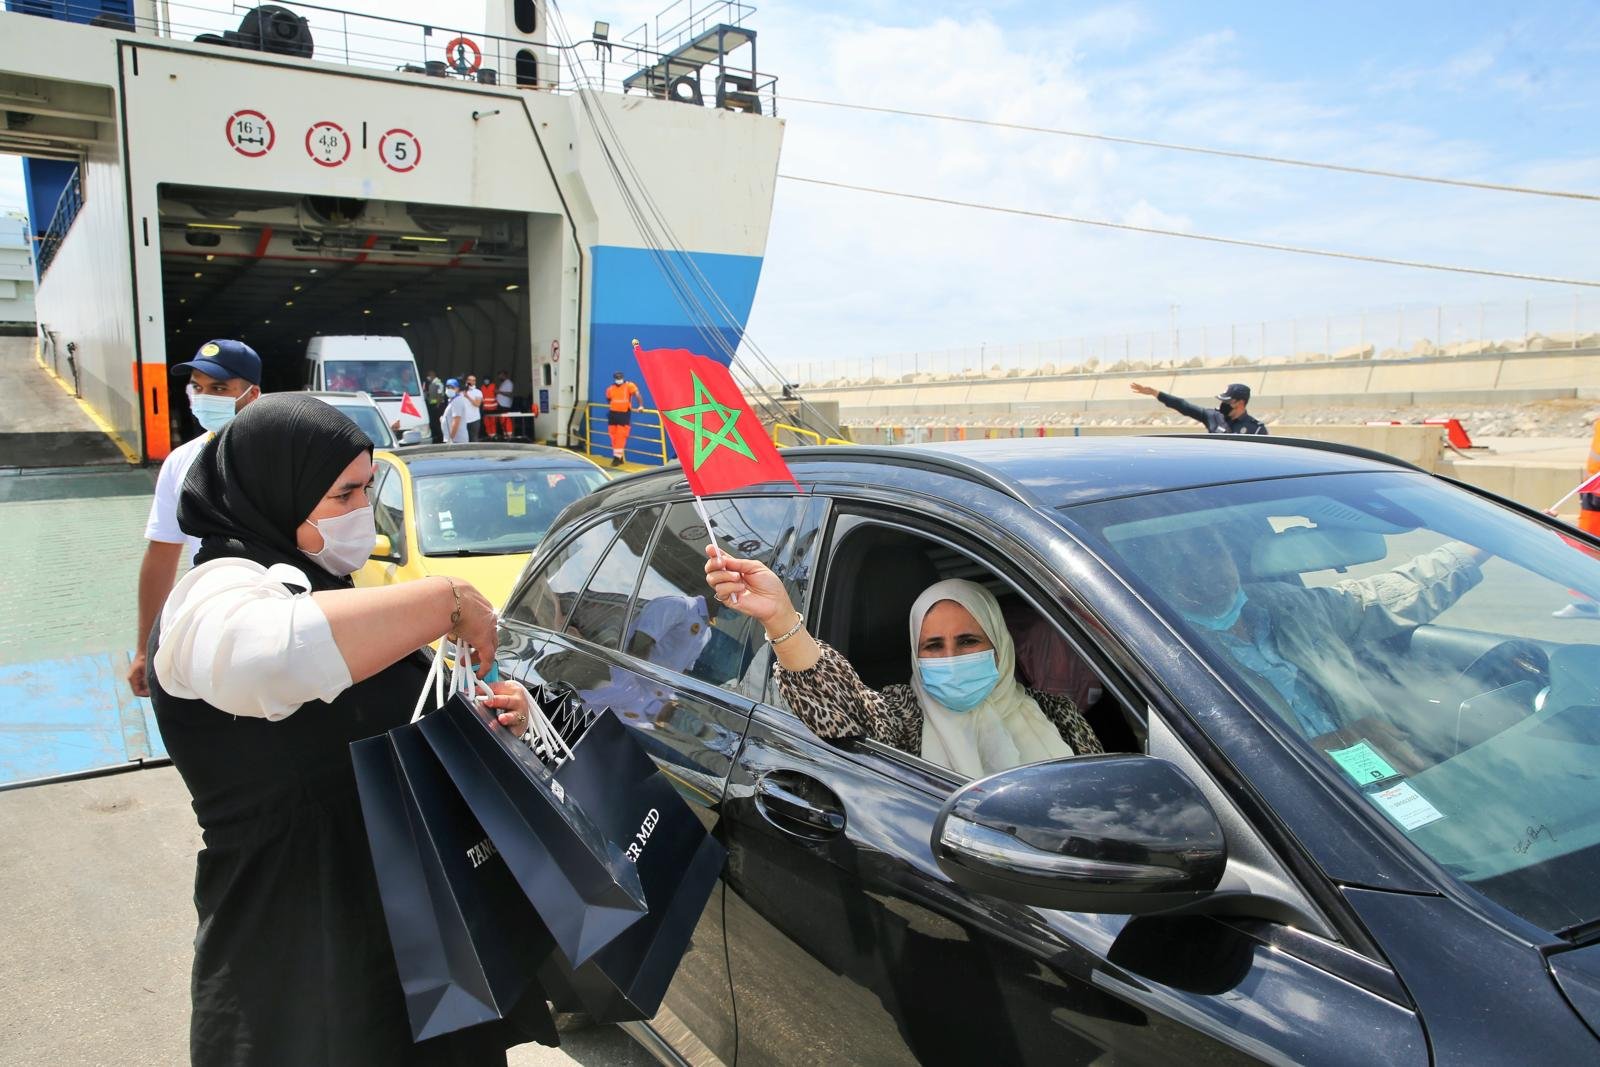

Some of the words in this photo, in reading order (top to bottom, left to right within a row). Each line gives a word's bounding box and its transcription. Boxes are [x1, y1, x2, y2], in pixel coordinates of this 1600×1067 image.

[237, 121, 253, 134] 16
[394, 142, 407, 160] 5
[636, 808, 660, 846] MED
